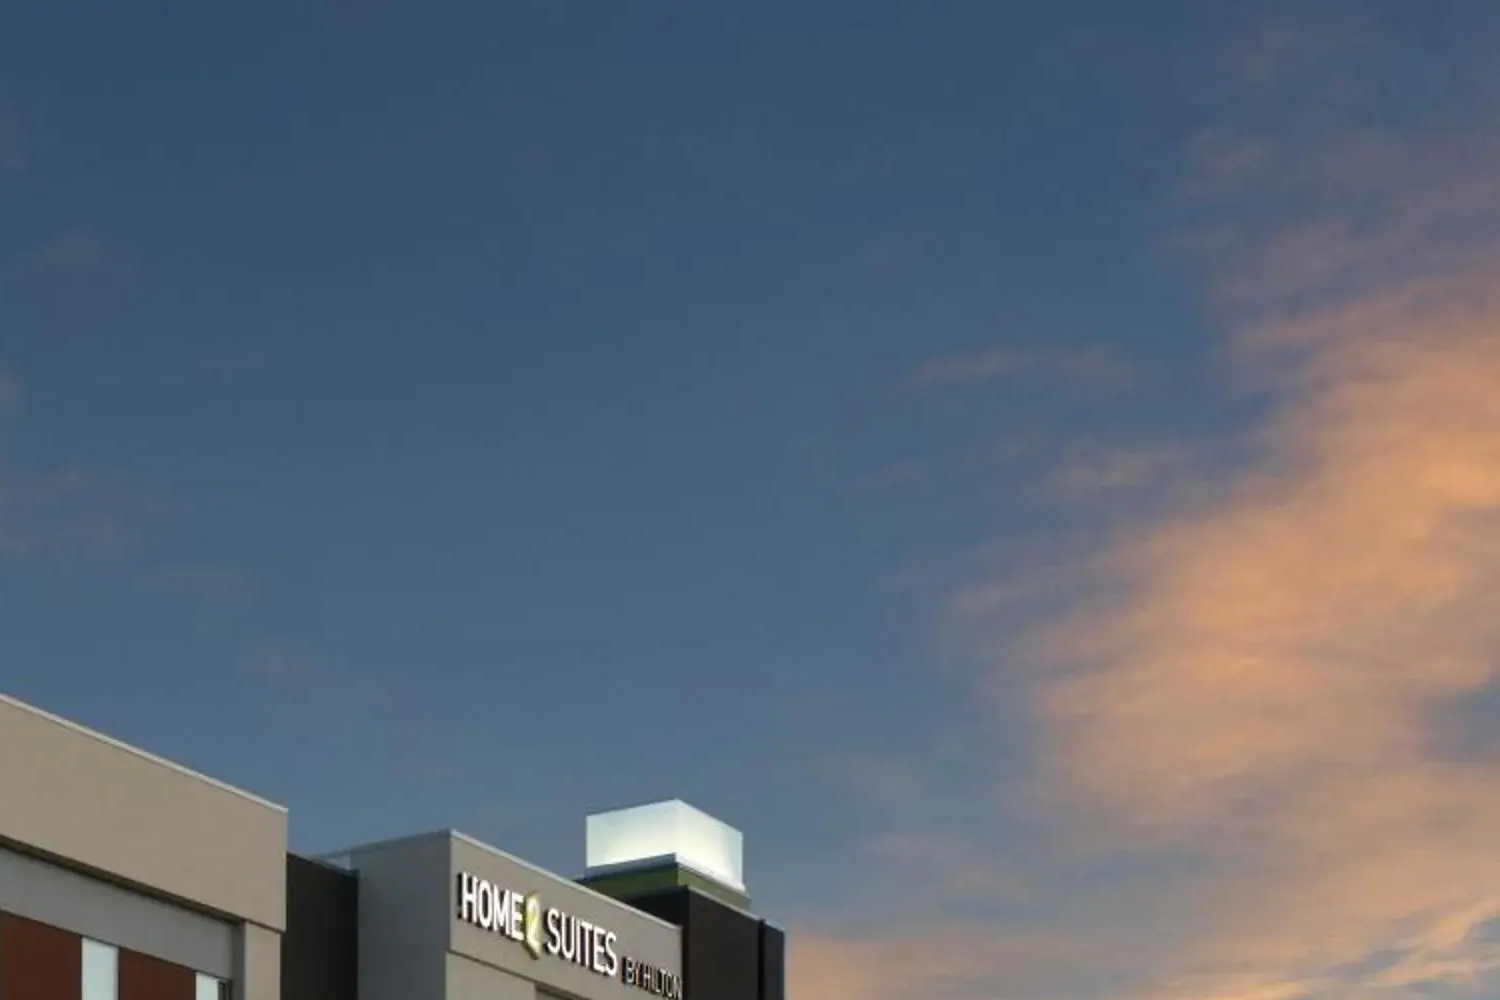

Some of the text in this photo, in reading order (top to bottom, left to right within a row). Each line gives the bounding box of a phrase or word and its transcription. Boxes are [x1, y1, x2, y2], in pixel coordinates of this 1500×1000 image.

[546, 907, 618, 977] SUITES
[626, 956, 640, 987] BY
[642, 961, 682, 1000] HILTON
